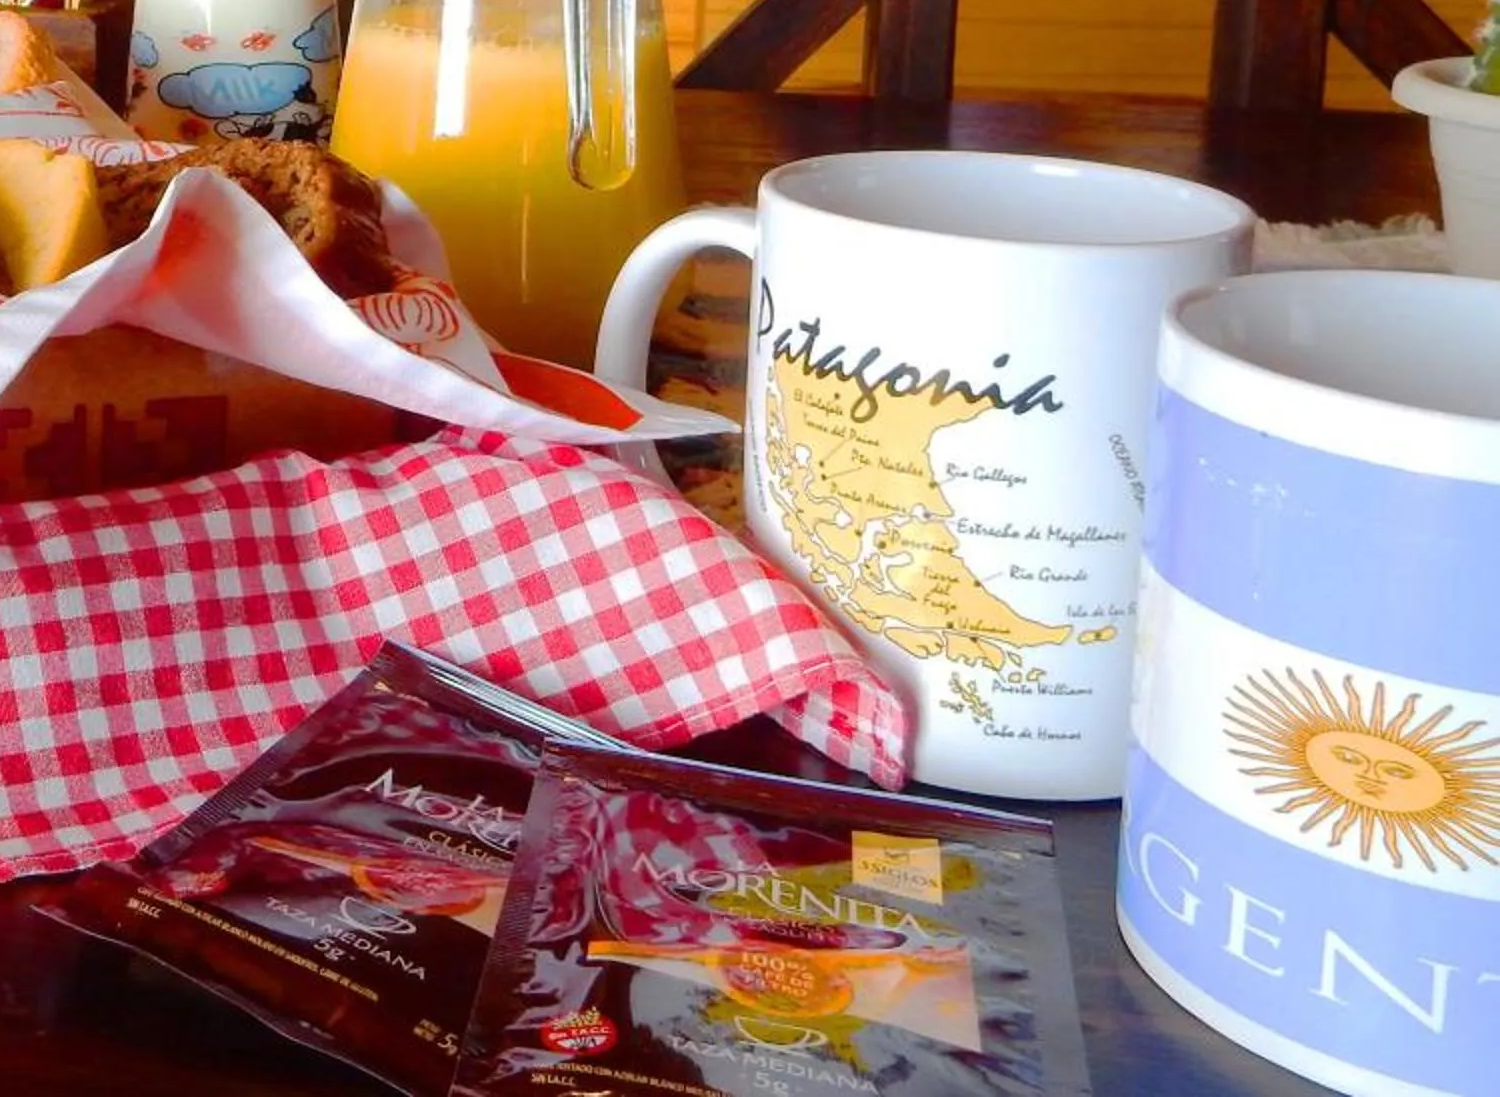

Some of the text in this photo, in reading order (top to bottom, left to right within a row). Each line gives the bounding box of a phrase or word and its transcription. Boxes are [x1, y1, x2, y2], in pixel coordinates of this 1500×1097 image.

[756, 277, 1064, 423] Patagonia
[973, 466, 1027, 488] Gallegos
[957, 517, 1127, 547] Estrecho de Magallanes
[1038, 567, 1088, 582] Grande
[992, 679, 1093, 696] Puerto Williams
[984, 723, 1082, 741] Cabo de Hornos
[632, 853, 933, 941] MORENITA
[265, 896, 316, 928] TAZA
[321, 923, 426, 981] MEDIANA
[667, 1034, 880, 1096] TAZA MEDIANA
